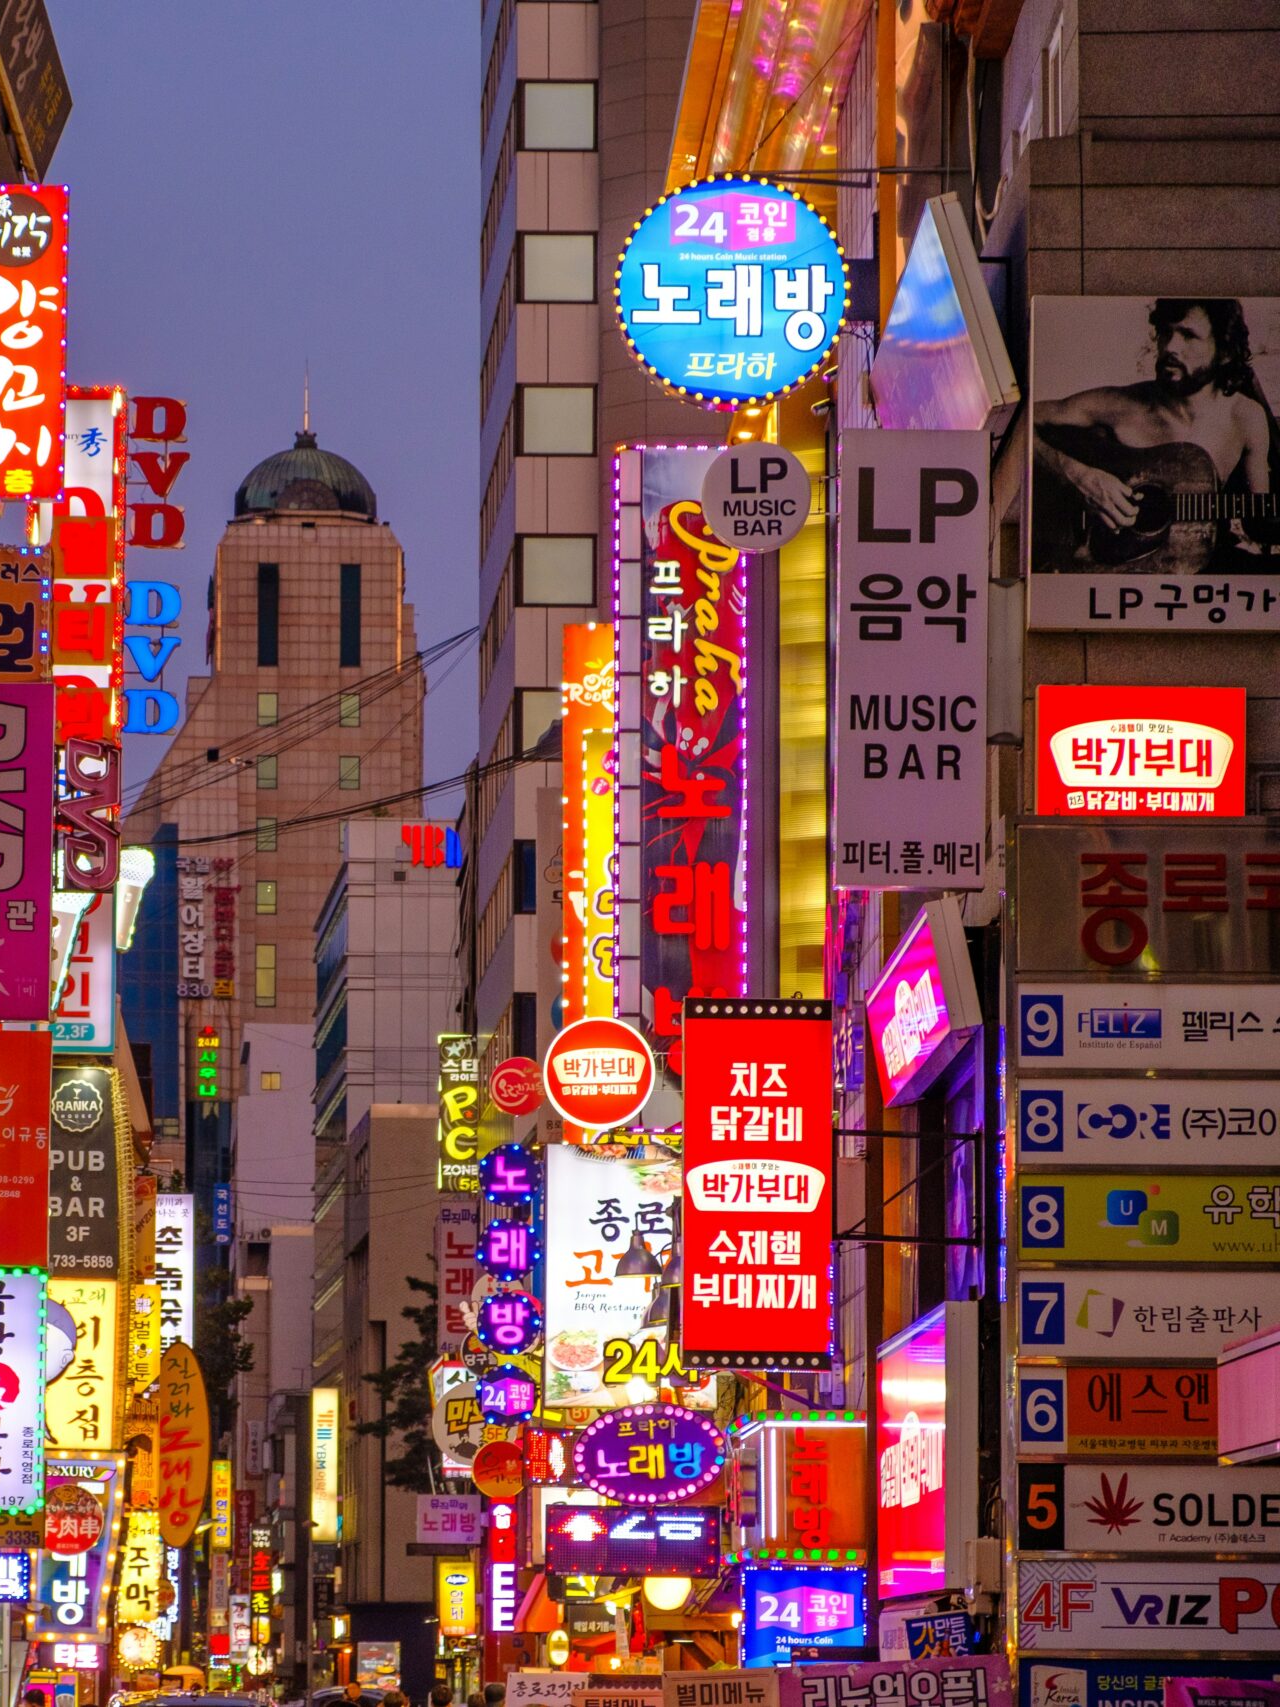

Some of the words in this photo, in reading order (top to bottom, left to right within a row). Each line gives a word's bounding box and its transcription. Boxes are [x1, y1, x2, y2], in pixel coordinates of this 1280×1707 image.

[674, 203, 727, 243] 24
[736, 201, 788, 227] 코인
[747, 228, 776, 241] 겸용
[679, 252, 691, 260] 24
[693, 252, 714, 260] hours
[716, 252, 732, 260] Coin
[734, 252, 756, 260] Music
[759, 252, 787, 260] station
[631, 264, 833, 351] 노래방
[684, 352, 777, 380] 프라하
[76, 427, 108, 457] 秀
[128, 396, 190, 548] DVD
[730, 457, 788, 494] LP
[723, 499, 796, 516] MUSIC
[857, 467, 979, 543] LP
[734, 524, 782, 537] BAR
[850, 573, 977, 643] 음악
[1089, 587, 1144, 620] LP
[1154, 583, 1280, 624] 구멍가
[648, 560, 688, 708] 프라하
[124, 580, 183, 734] DVD
[849, 694, 977, 732] MUSIC
[863, 743, 961, 780] BAR
[1071, 737, 1214, 778] 박가부대
[842, 841, 981, 875] 피터.폴.메리
[55, 1024, 89, 1039] 2,3F
[1026, 1002, 1058, 1048] 9
[1182, 1011, 1264, 1042] 펠리스
[1079, 1040, 1114, 1049] Instituto
[1117, 1040, 1127, 1049] de
[1129, 1040, 1162, 1051] Español
[199, 1051, 218, 1097] 사우나
[442, 1060, 478, 1073] 스타
[563, 1057, 635, 1078] 박가부대
[730, 1062, 788, 1098] 치즈
[56, 1101, 98, 1112] RANKA
[442, 1085, 478, 1160] PC
[1026, 1098, 1058, 1144] 8
[1077, 1103, 1170, 1140] CORE
[2, 1126, 49, 1149] 이규동
[710, 1106, 803, 1142] 닭갈비
[49, 1150, 106, 1171] PUB
[442, 1165, 478, 1176] ZONE
[70, 1176, 82, 1192] &
[702, 1173, 809, 1204] 박가부대
[49, 1197, 105, 1218] BAR
[1027, 1194, 1059, 1240] 8
[1120, 1199, 1133, 1216] U
[66, 1226, 90, 1242] 3F
[1150, 1219, 1168, 1236] M
[53, 1253, 114, 1269] 733-5858
[486, 1156, 532, 1344] 노래방
[708, 1230, 801, 1266] 수제햄
[692, 1273, 817, 1309] 부대찌개
[1028, 1292, 1058, 1335] 7
[1133, 1306, 1262, 1334] 한림출판사
[66, 1315, 104, 1442] 이층집
[509, 1384, 531, 1399] 코인
[484, 1386, 506, 1410] 24
[1026, 1388, 1057, 1433] 6
[1087, 1373, 1210, 1424] 에스앤
[486, 1429, 503, 1441] 5F
[617, 1418, 678, 1438] 프라하
[159, 1415, 203, 1527] 노래방
[597, 1443, 705, 1480] 노래방
[791, 1427, 832, 1549] 노래방
[423, 1512, 476, 1533] 노래방
[1026, 1484, 1057, 1529] 5
[1158, 1534, 1167, 1543] IT
[1169, 1533, 1211, 1545] Academy
[126, 1547, 158, 1611] 주막
[759, 1596, 801, 1628] 24
[807, 1594, 848, 1615] 코인
[1023, 1580, 1096, 1633] 4F
[53, 1644, 100, 1668] 타로
[776, 1636, 786, 1644] 24
[788, 1636, 812, 1645] hours
[814, 1636, 833, 1645] Coin
[676, 1681, 766, 1707] 별미메뉴
